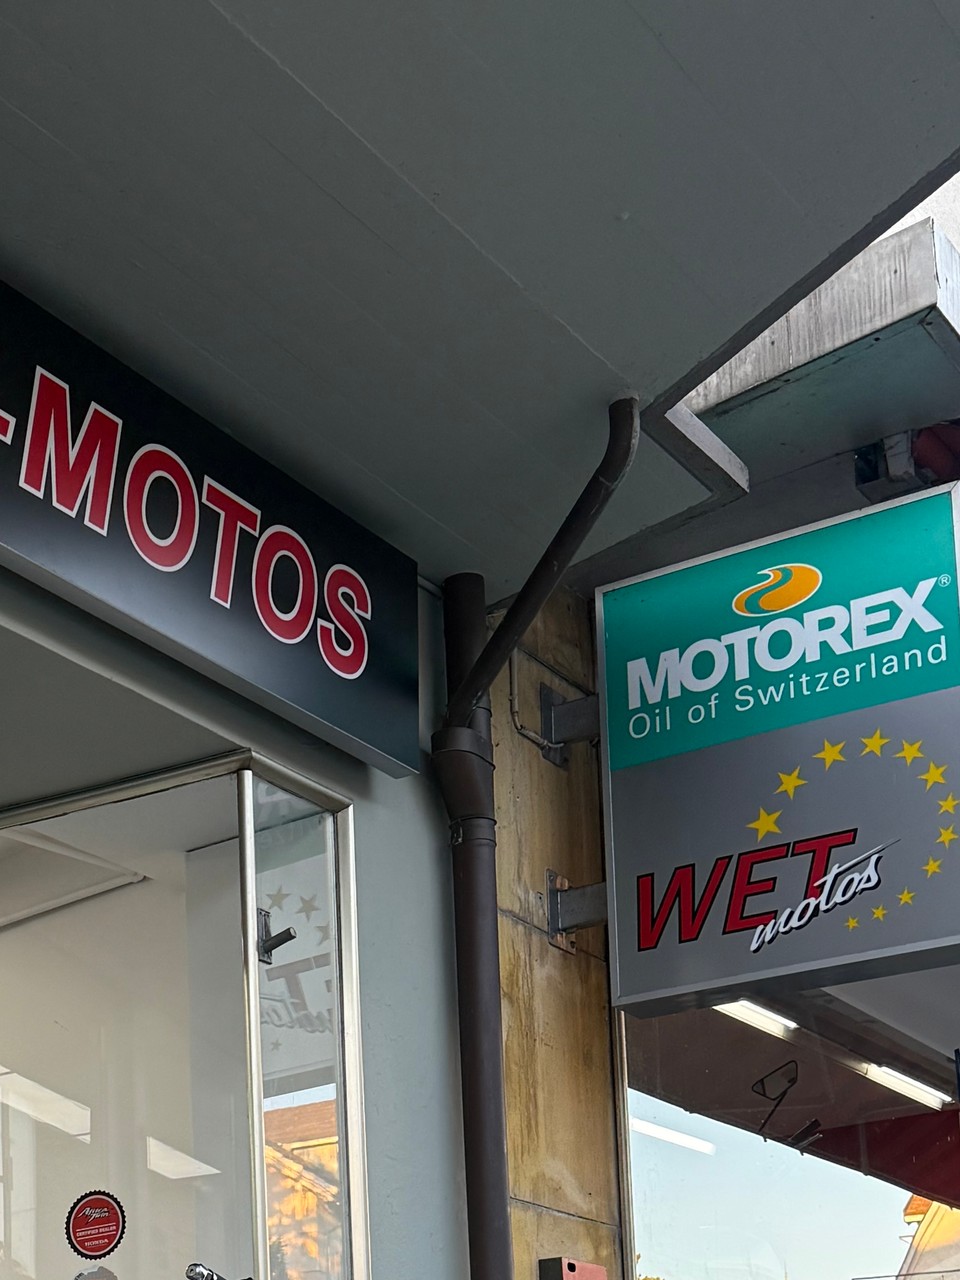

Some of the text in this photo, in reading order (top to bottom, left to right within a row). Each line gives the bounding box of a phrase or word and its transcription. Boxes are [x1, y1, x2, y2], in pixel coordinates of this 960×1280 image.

[626, 577, 944, 710] MOTOREX
[627, 635, 948, 740] Oil of Switzerland
[637, 828, 858, 952] WET
[749, 838, 901, 954] motos
